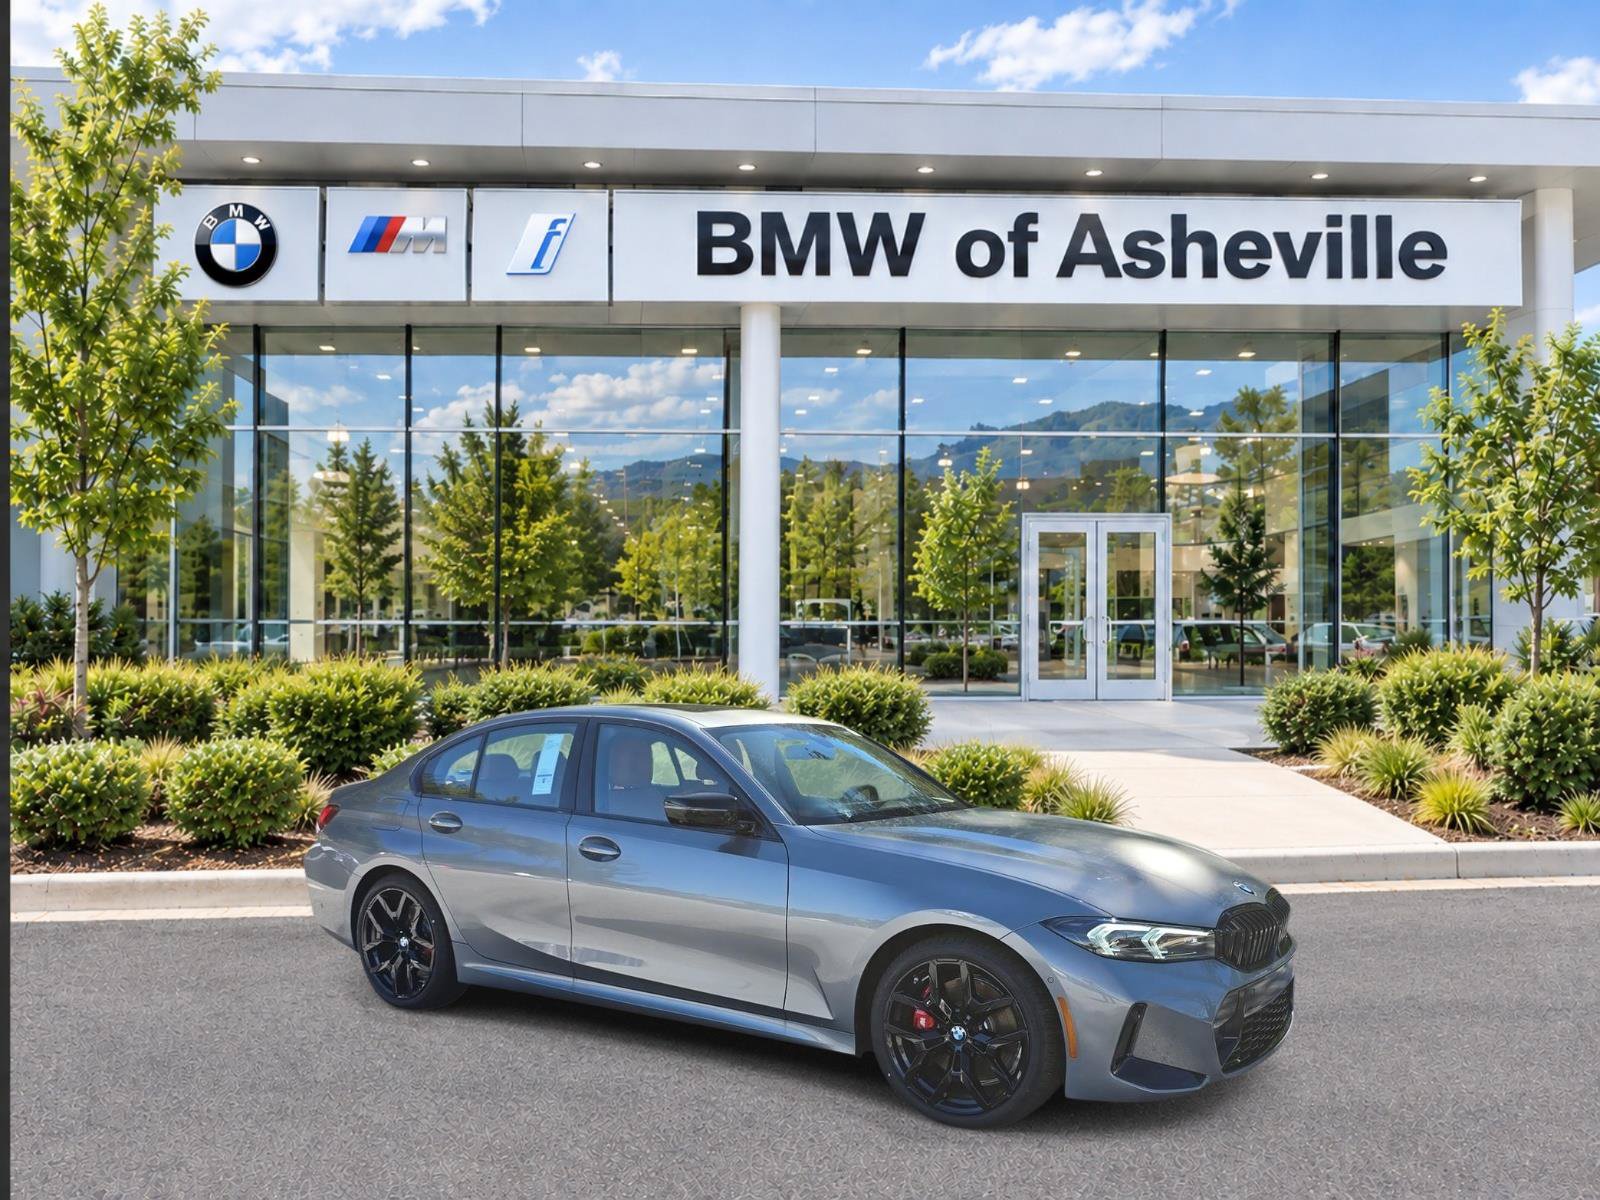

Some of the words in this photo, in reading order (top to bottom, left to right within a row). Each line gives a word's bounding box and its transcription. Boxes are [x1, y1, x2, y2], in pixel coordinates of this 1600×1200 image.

[202, 204, 271, 231] BMW
[697, 210, 926, 277] BMW
[955, 212, 1039, 279] of
[1056, 213, 1448, 281] Asheville
